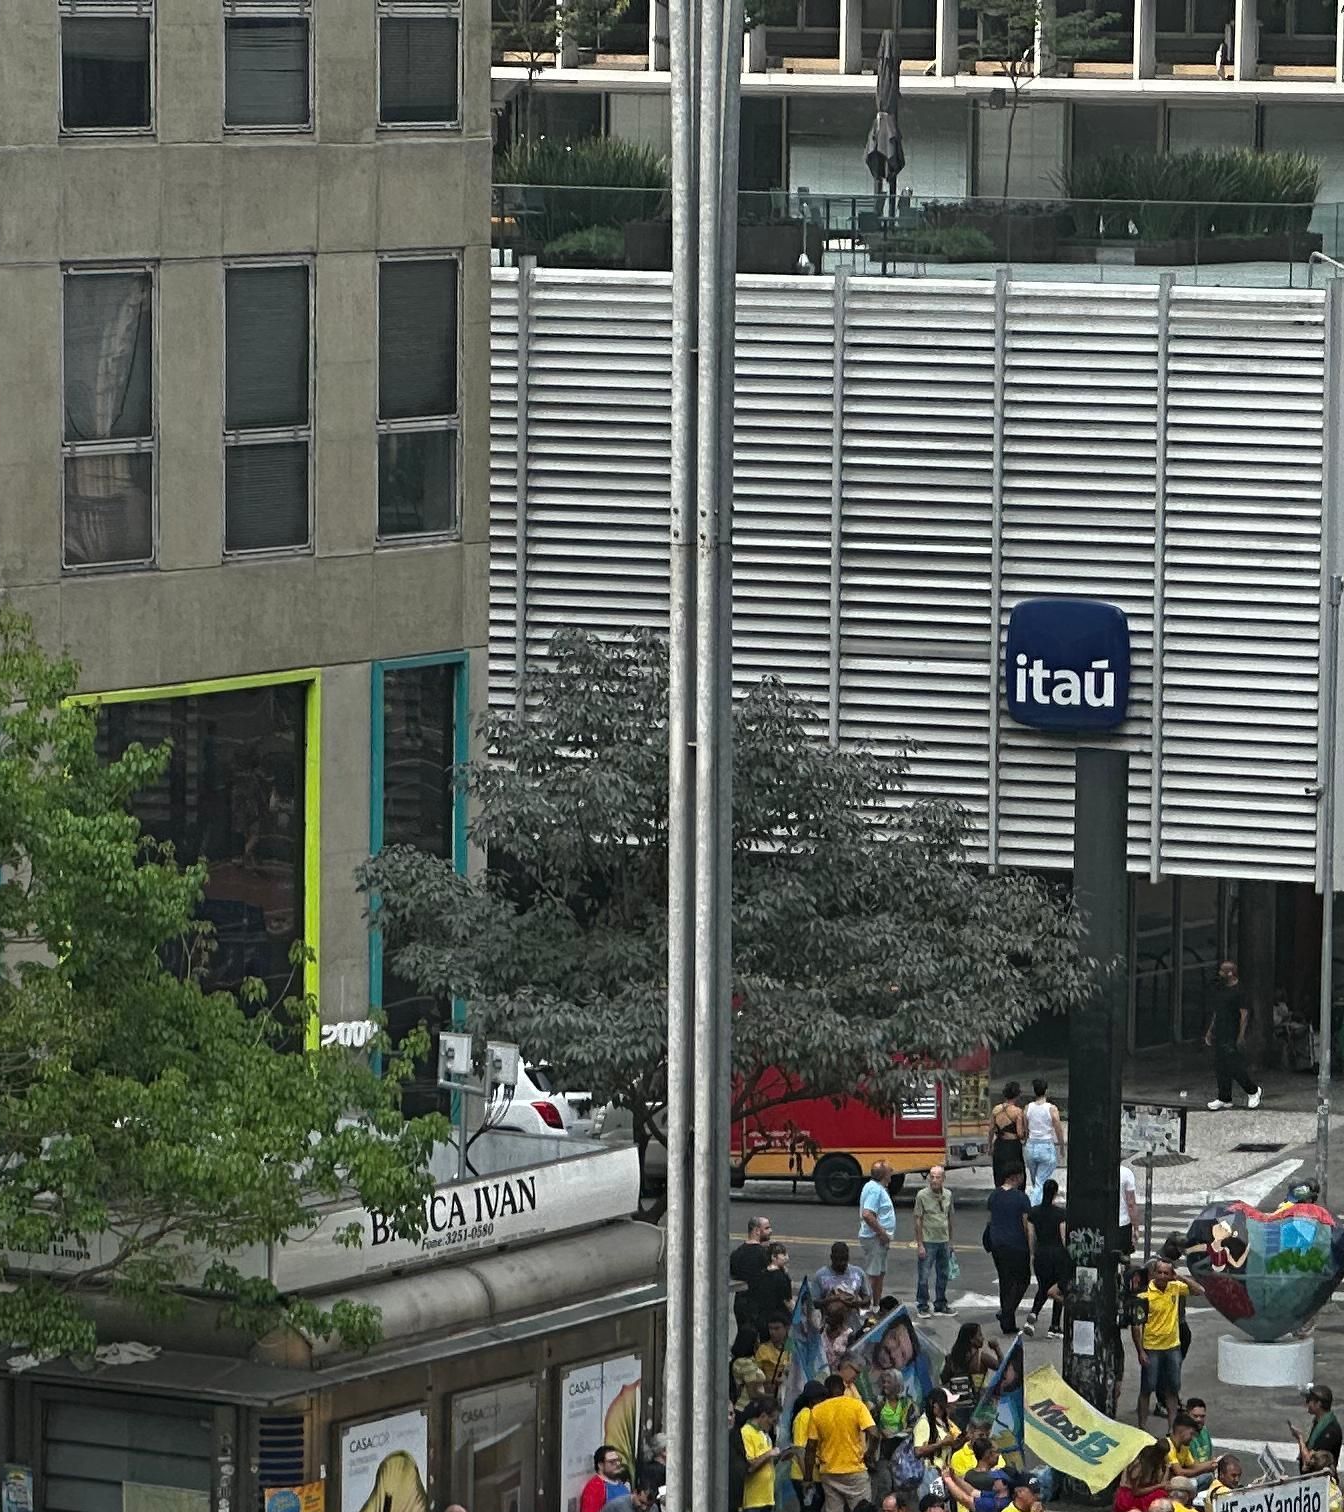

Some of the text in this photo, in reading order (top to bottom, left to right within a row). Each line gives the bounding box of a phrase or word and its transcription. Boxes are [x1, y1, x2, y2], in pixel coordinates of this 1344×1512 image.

[1016, 653, 1116, 708] itaú
[473, 1176, 537, 1223] IVAN
[445, 1223, 494, 1246] 3251-0580
